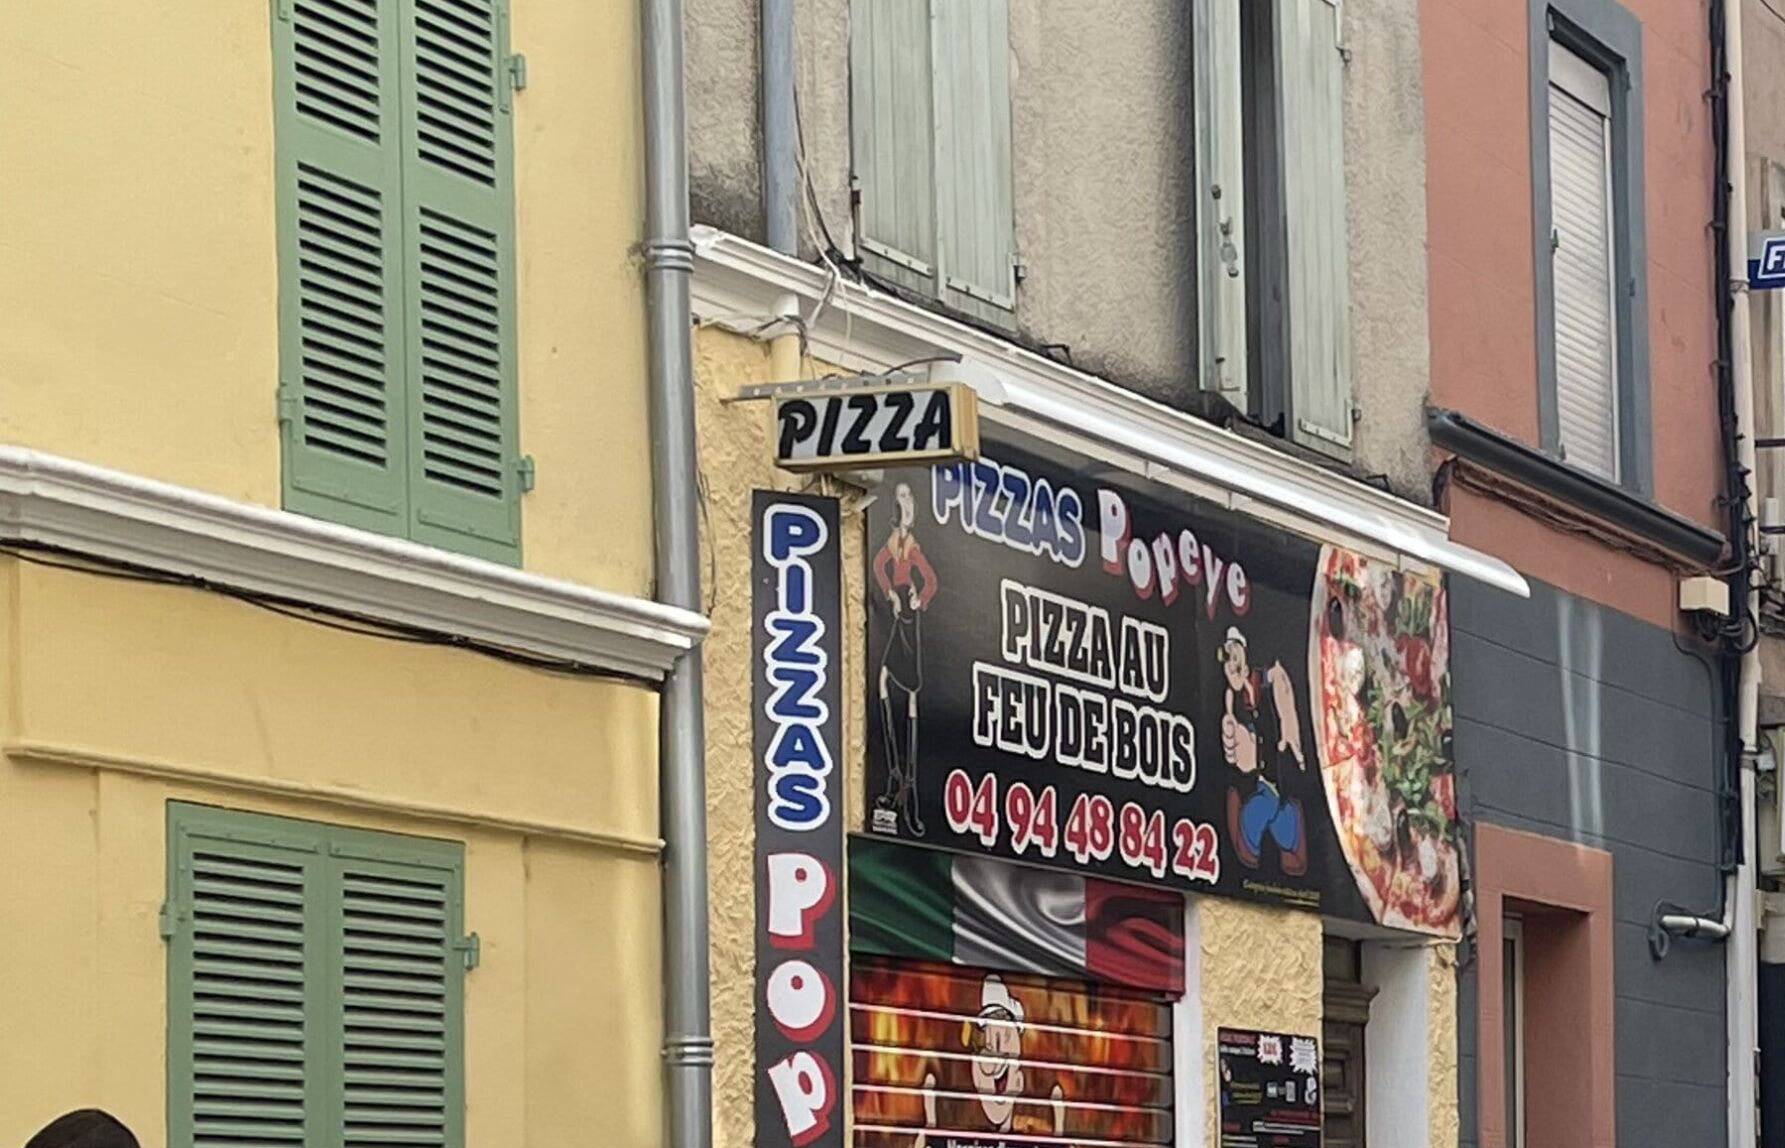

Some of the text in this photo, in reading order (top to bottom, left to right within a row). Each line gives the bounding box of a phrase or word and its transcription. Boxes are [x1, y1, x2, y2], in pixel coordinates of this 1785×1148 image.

[778, 390, 951, 459] PIZZA
[932, 462, 1251, 619] PIZZAS Popeye
[763, 503, 833, 831] PIZZAS
[1001, 579, 1168, 702] PIZZA AU
[972, 662, 1197, 793] FEU DE BOIS
[945, 769, 1220, 883] 04 94 48 84 22
